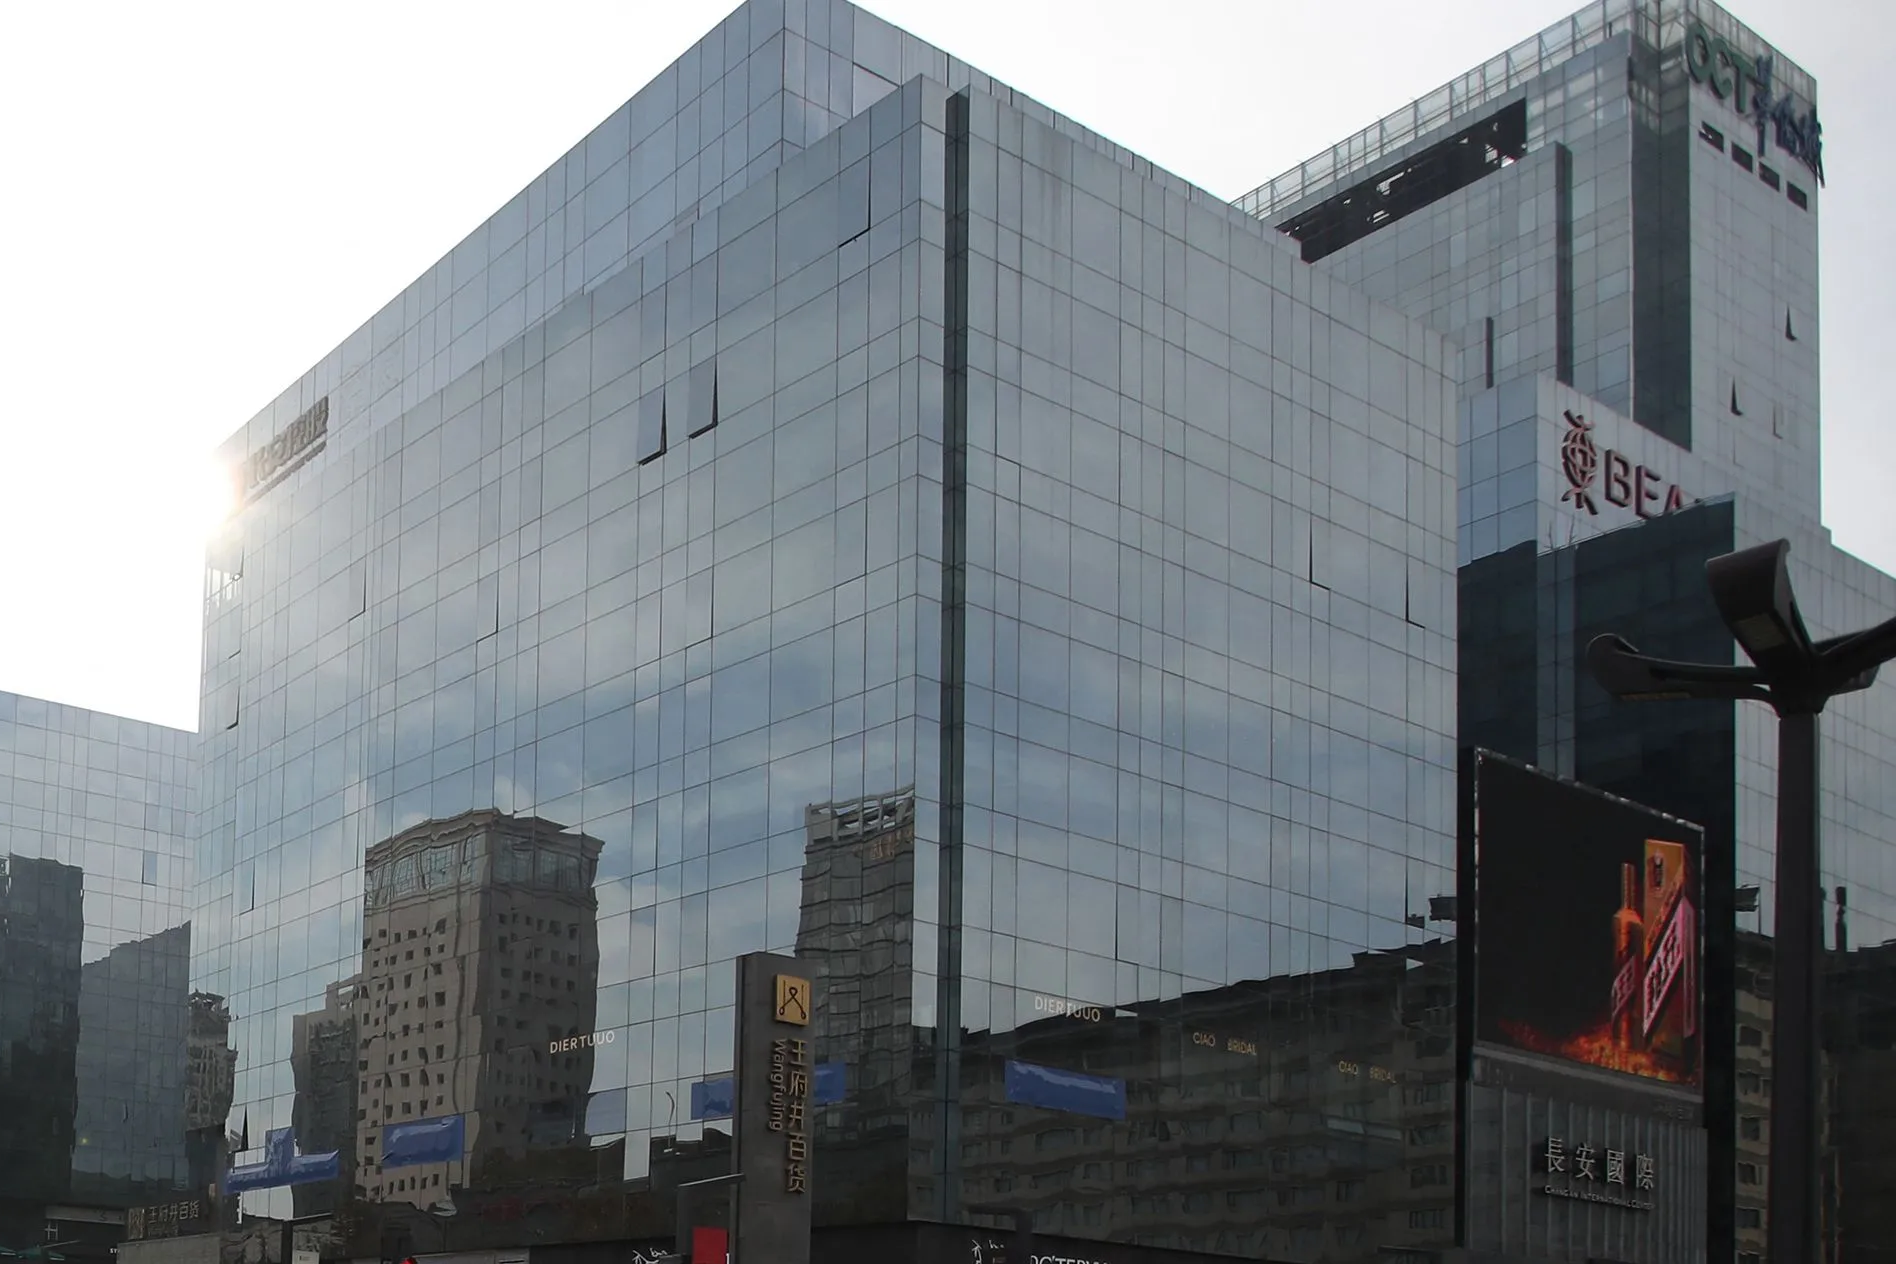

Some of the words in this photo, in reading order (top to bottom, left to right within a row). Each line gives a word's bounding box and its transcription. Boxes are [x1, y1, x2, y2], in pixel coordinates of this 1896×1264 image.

[550, 1030, 615, 1054] DIERTUUO
[769, 1038, 787, 1131] Wangfujing
[788, 1037, 808, 1193] 王府井百货
[1544, 1137, 1654, 1190] 長安國際
